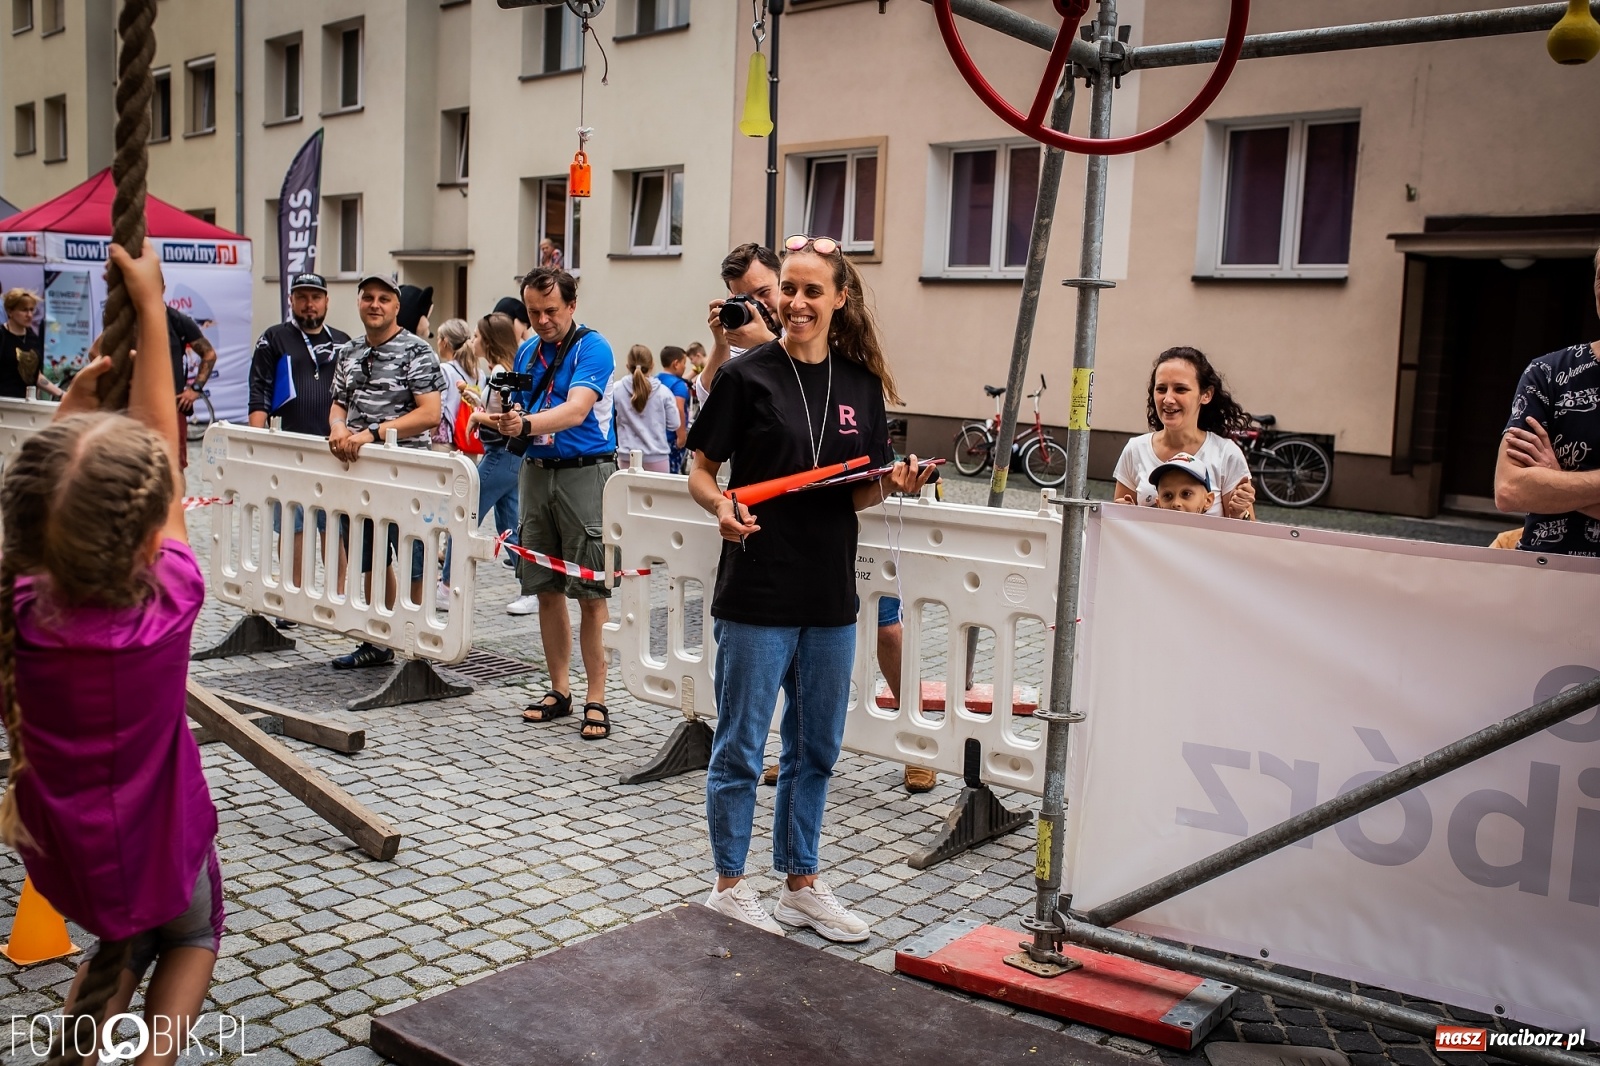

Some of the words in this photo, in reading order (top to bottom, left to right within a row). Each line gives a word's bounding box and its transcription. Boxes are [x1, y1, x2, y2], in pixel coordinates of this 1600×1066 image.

[66, 241, 111, 260] nowi
[287, 188, 313, 294] NESS
[164, 242, 235, 264] nowiny.pl
[838, 404, 857, 427] R
[1536, 517, 1569, 530] NEW
[1531, 524, 1568, 546] YORK
[855, 568, 871, 581] ÓRZ
